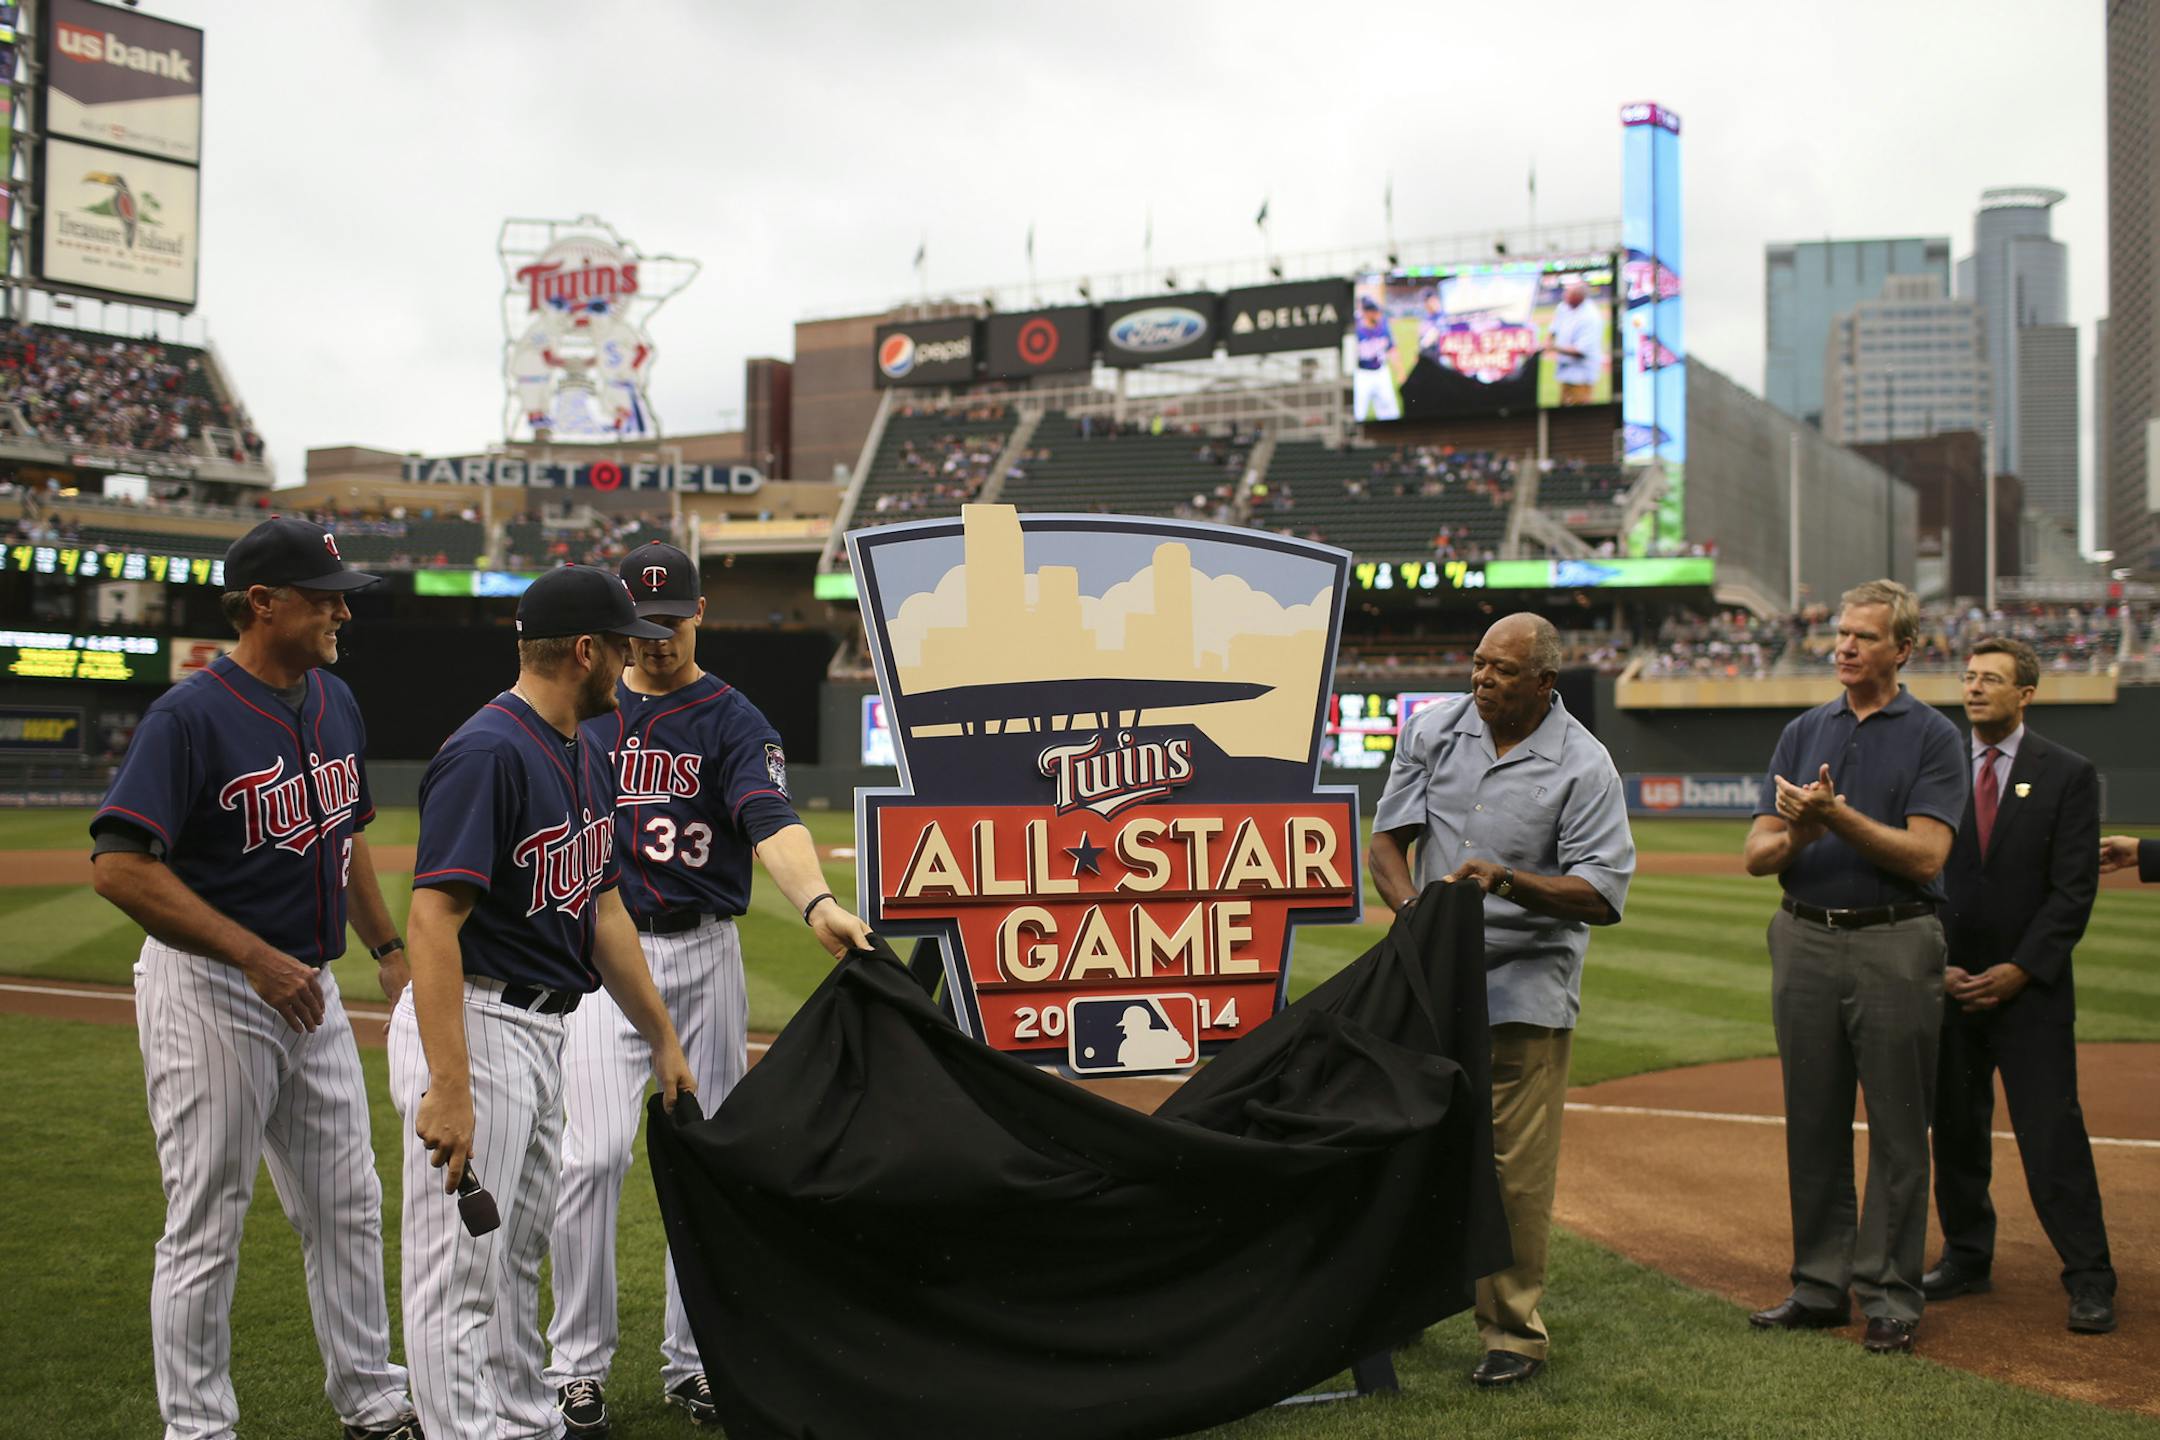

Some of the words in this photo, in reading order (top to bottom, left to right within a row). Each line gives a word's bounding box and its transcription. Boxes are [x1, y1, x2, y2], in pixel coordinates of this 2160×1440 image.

[516, 258, 639, 312] Twins
[1126, 312, 1192, 344] Ford
[1257, 303, 1339, 331] DELTA
[914, 334, 972, 365] pepsi
[402, 458, 581, 489] TARGET
[629, 463, 764, 494] FIELD
[1038, 731, 1194, 820] Twins
[219, 752, 360, 857] Twins
[644, 816, 714, 868] 33
[897, 818, 1080, 898] ALL
[1114, 816, 1346, 894] STAR
[996, 901, 1262, 983] GAME
